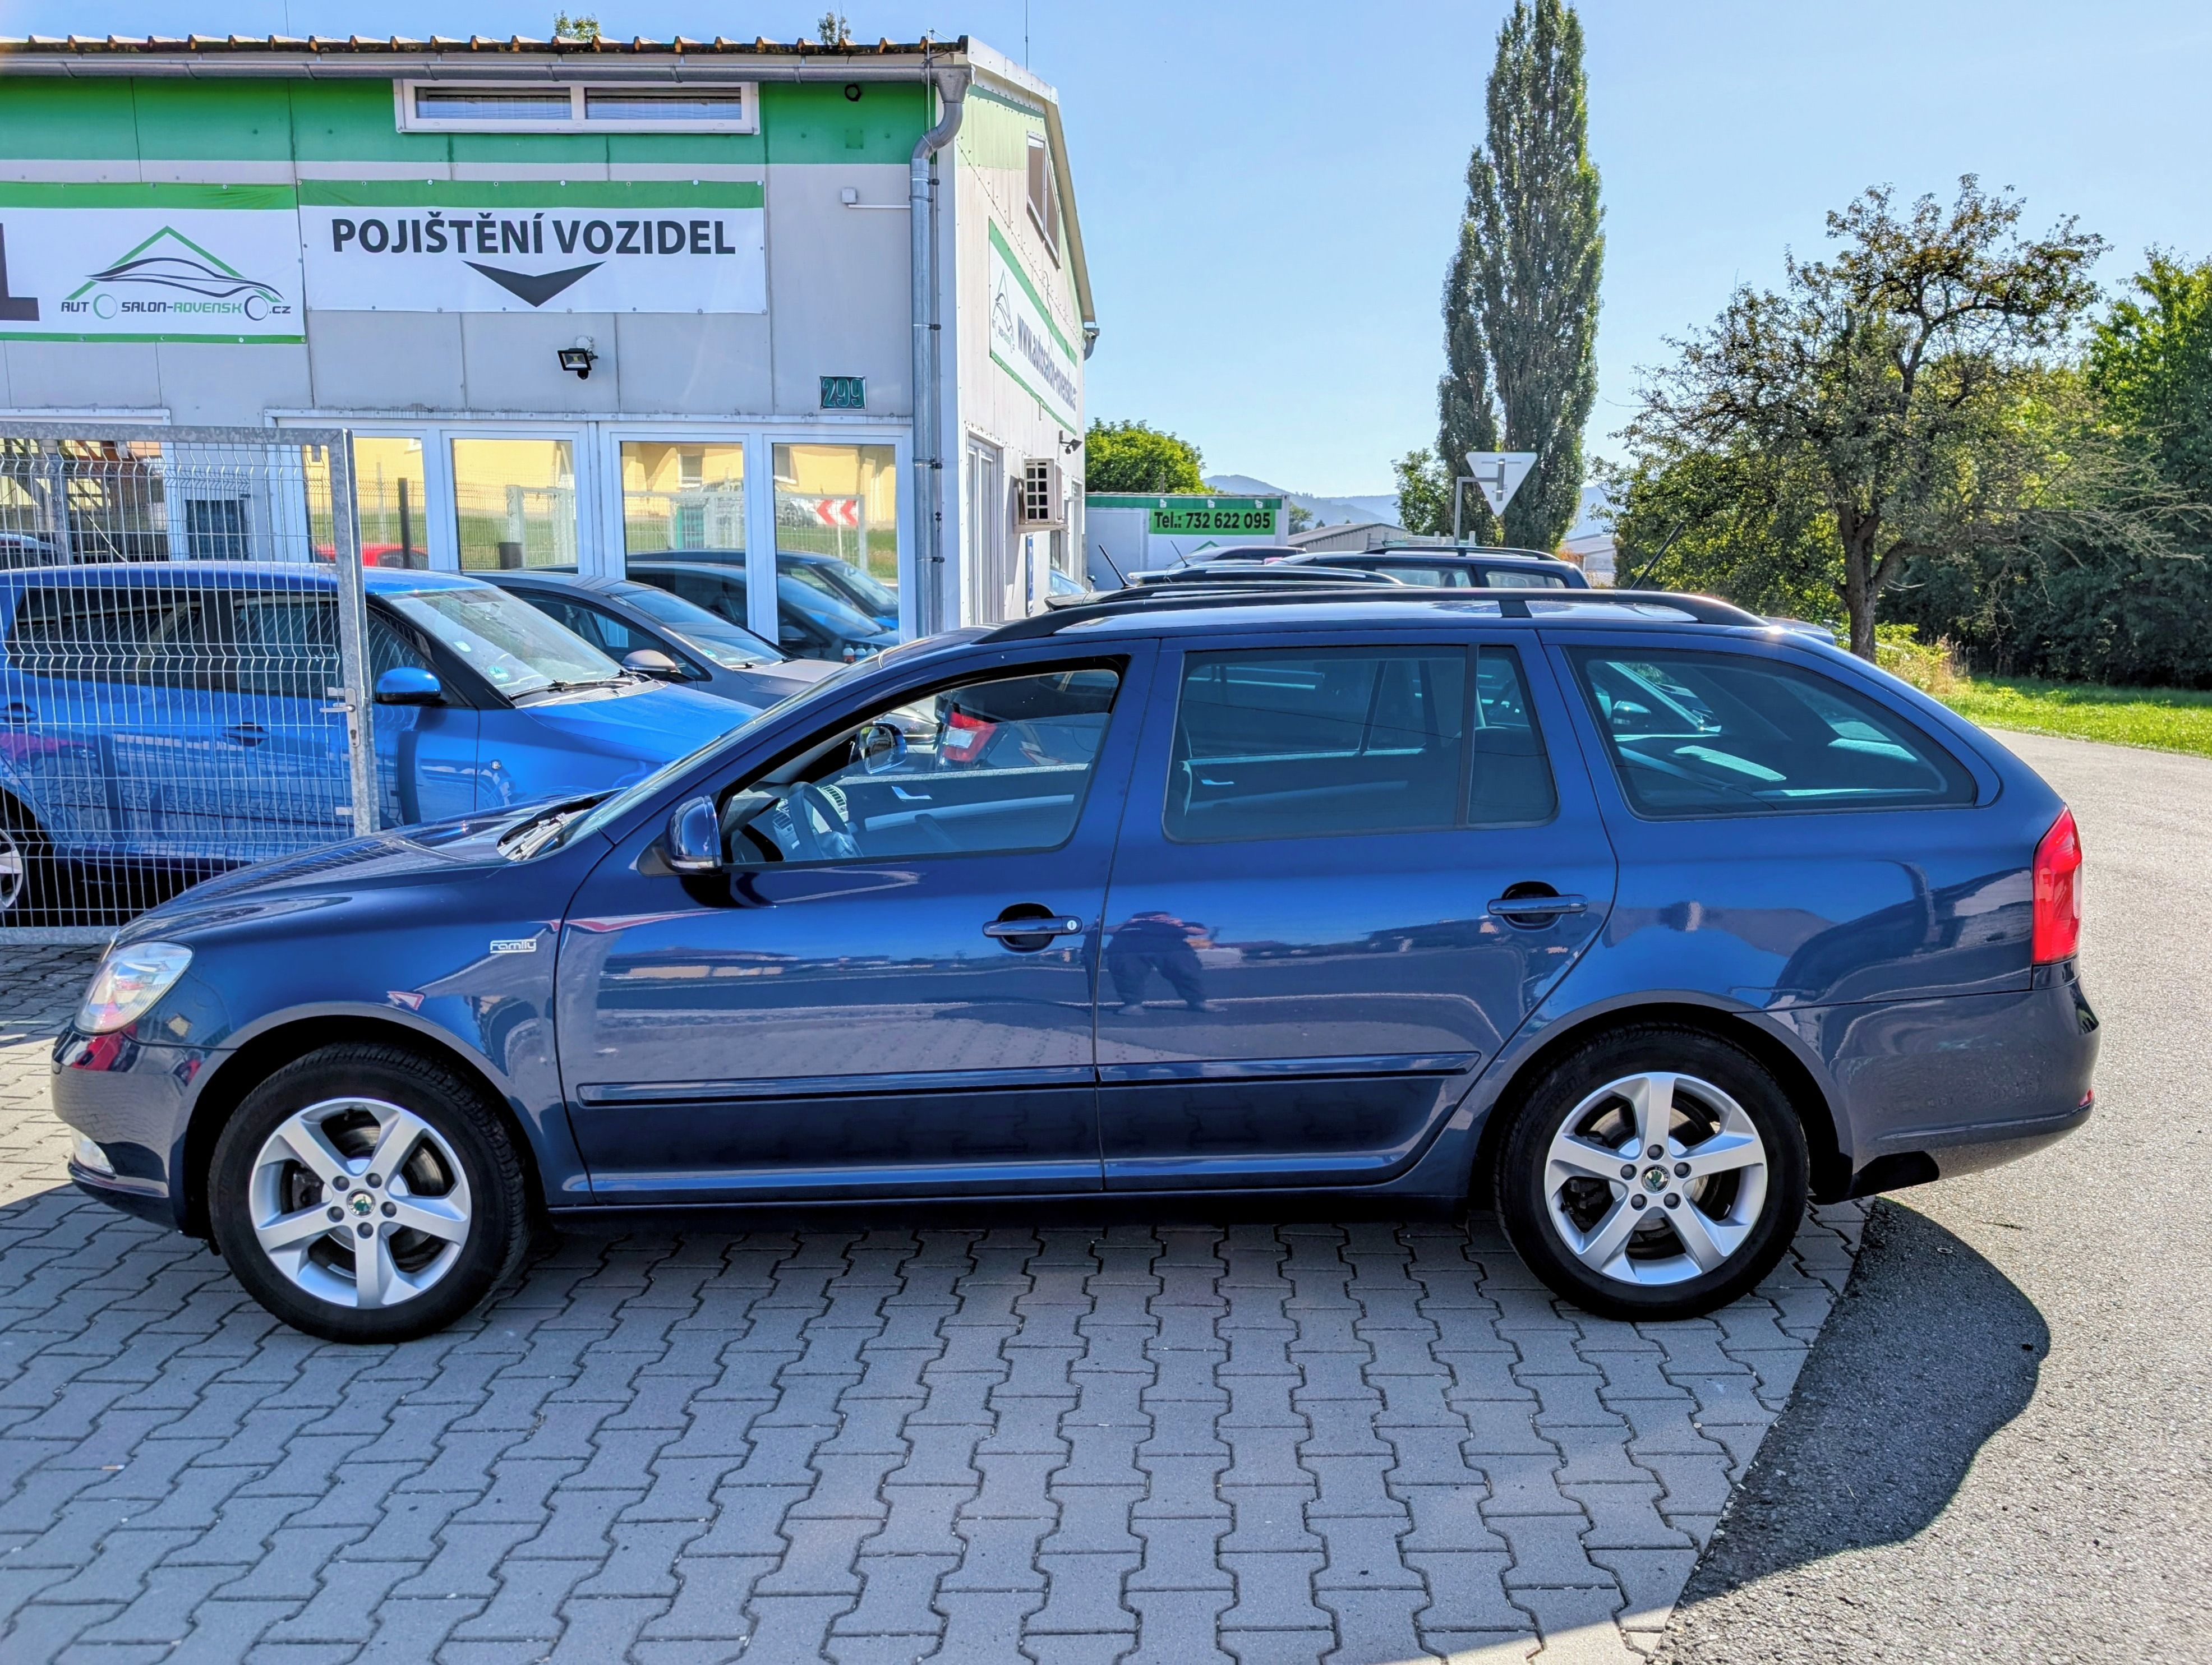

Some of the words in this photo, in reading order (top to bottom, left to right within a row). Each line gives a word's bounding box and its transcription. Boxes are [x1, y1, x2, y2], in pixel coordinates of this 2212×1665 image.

[332, 211, 545, 253] POJIŠTĚNÍ
[552, 220, 736, 254] VOZIDEL
[822, 377, 864, 407] 299
[1154, 511, 1182, 528] Tel.:
[1186, 512, 1210, 529] 732
[1214, 512, 1239, 529] 622
[1243, 512, 1270, 529] 095
